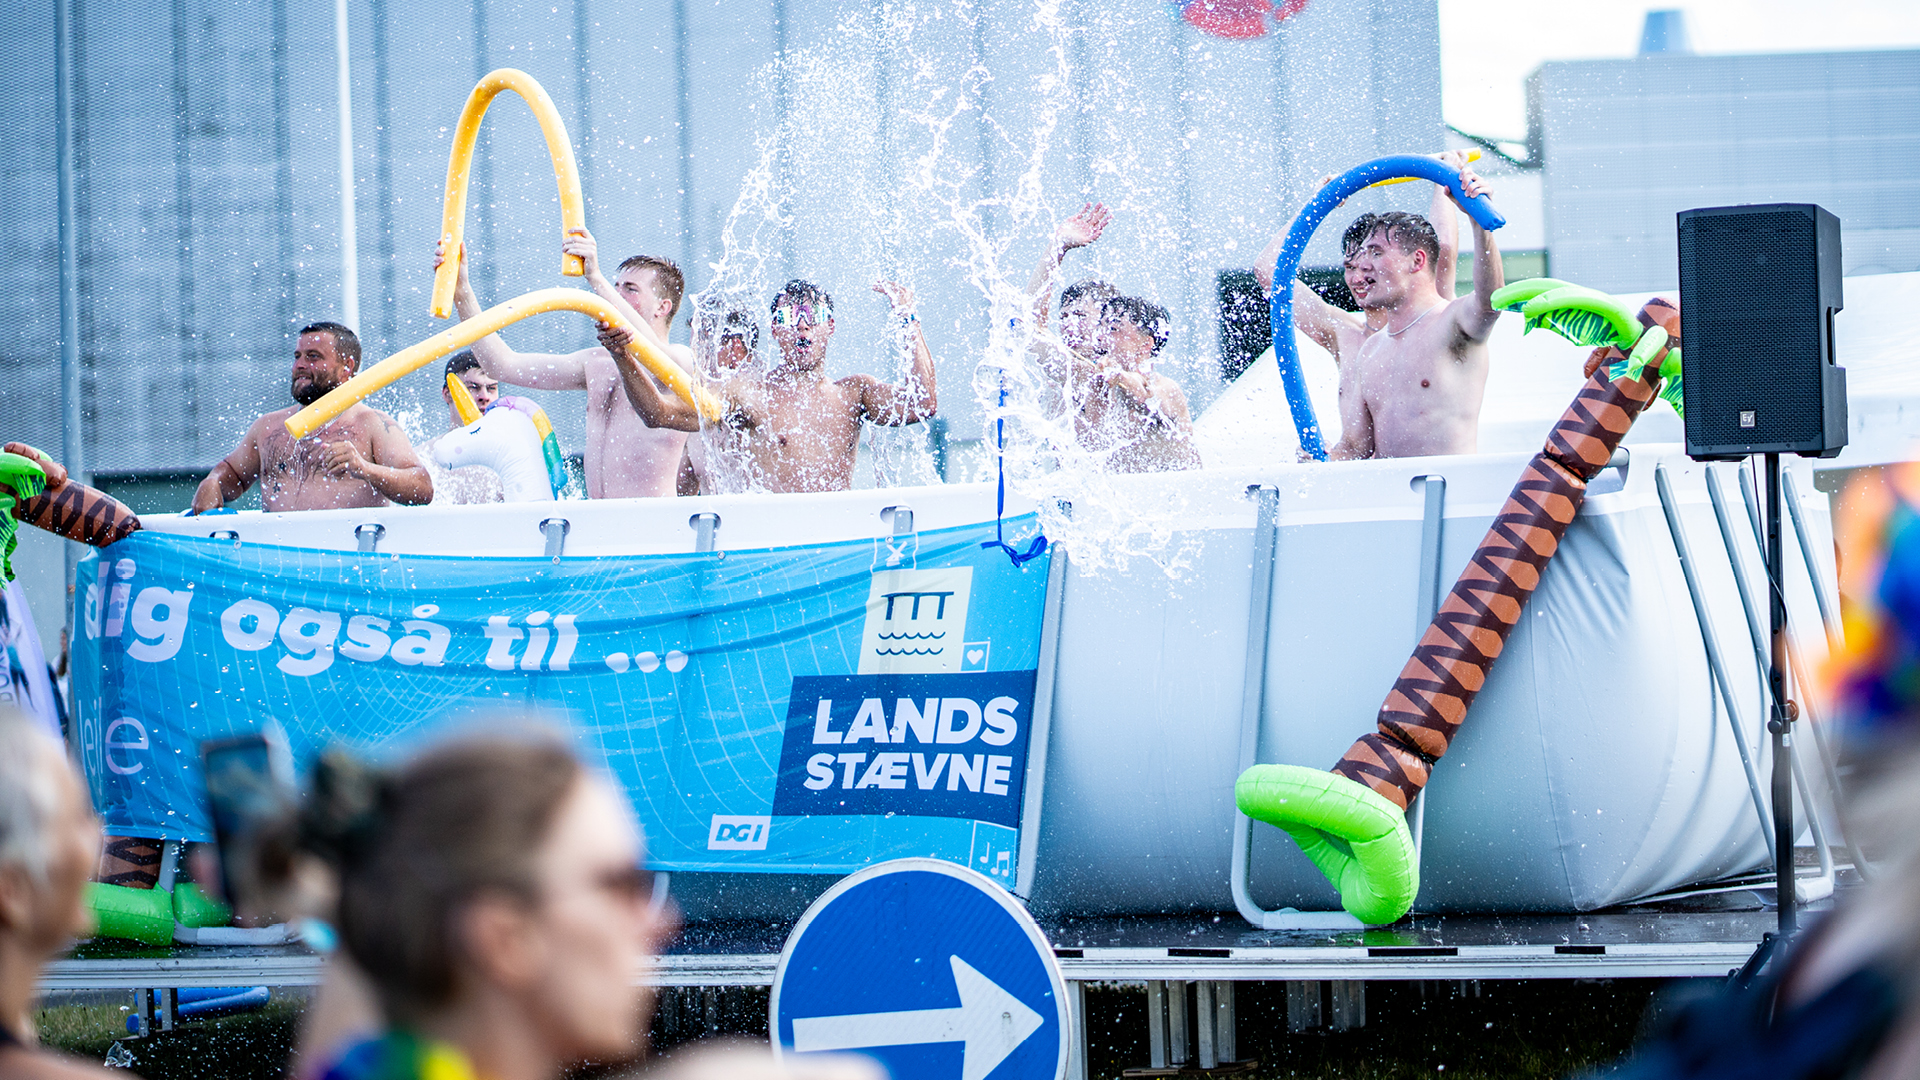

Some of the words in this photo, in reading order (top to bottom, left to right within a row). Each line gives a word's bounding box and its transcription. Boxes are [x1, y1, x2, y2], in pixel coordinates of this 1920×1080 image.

[84, 558, 194, 663] dig
[220, 599, 451, 677] også
[483, 610, 579, 672] til
[812, 696, 1019, 746] LANDS
[803, 753, 1013, 796] STÆVNE
[715, 824, 763, 843] DGI
